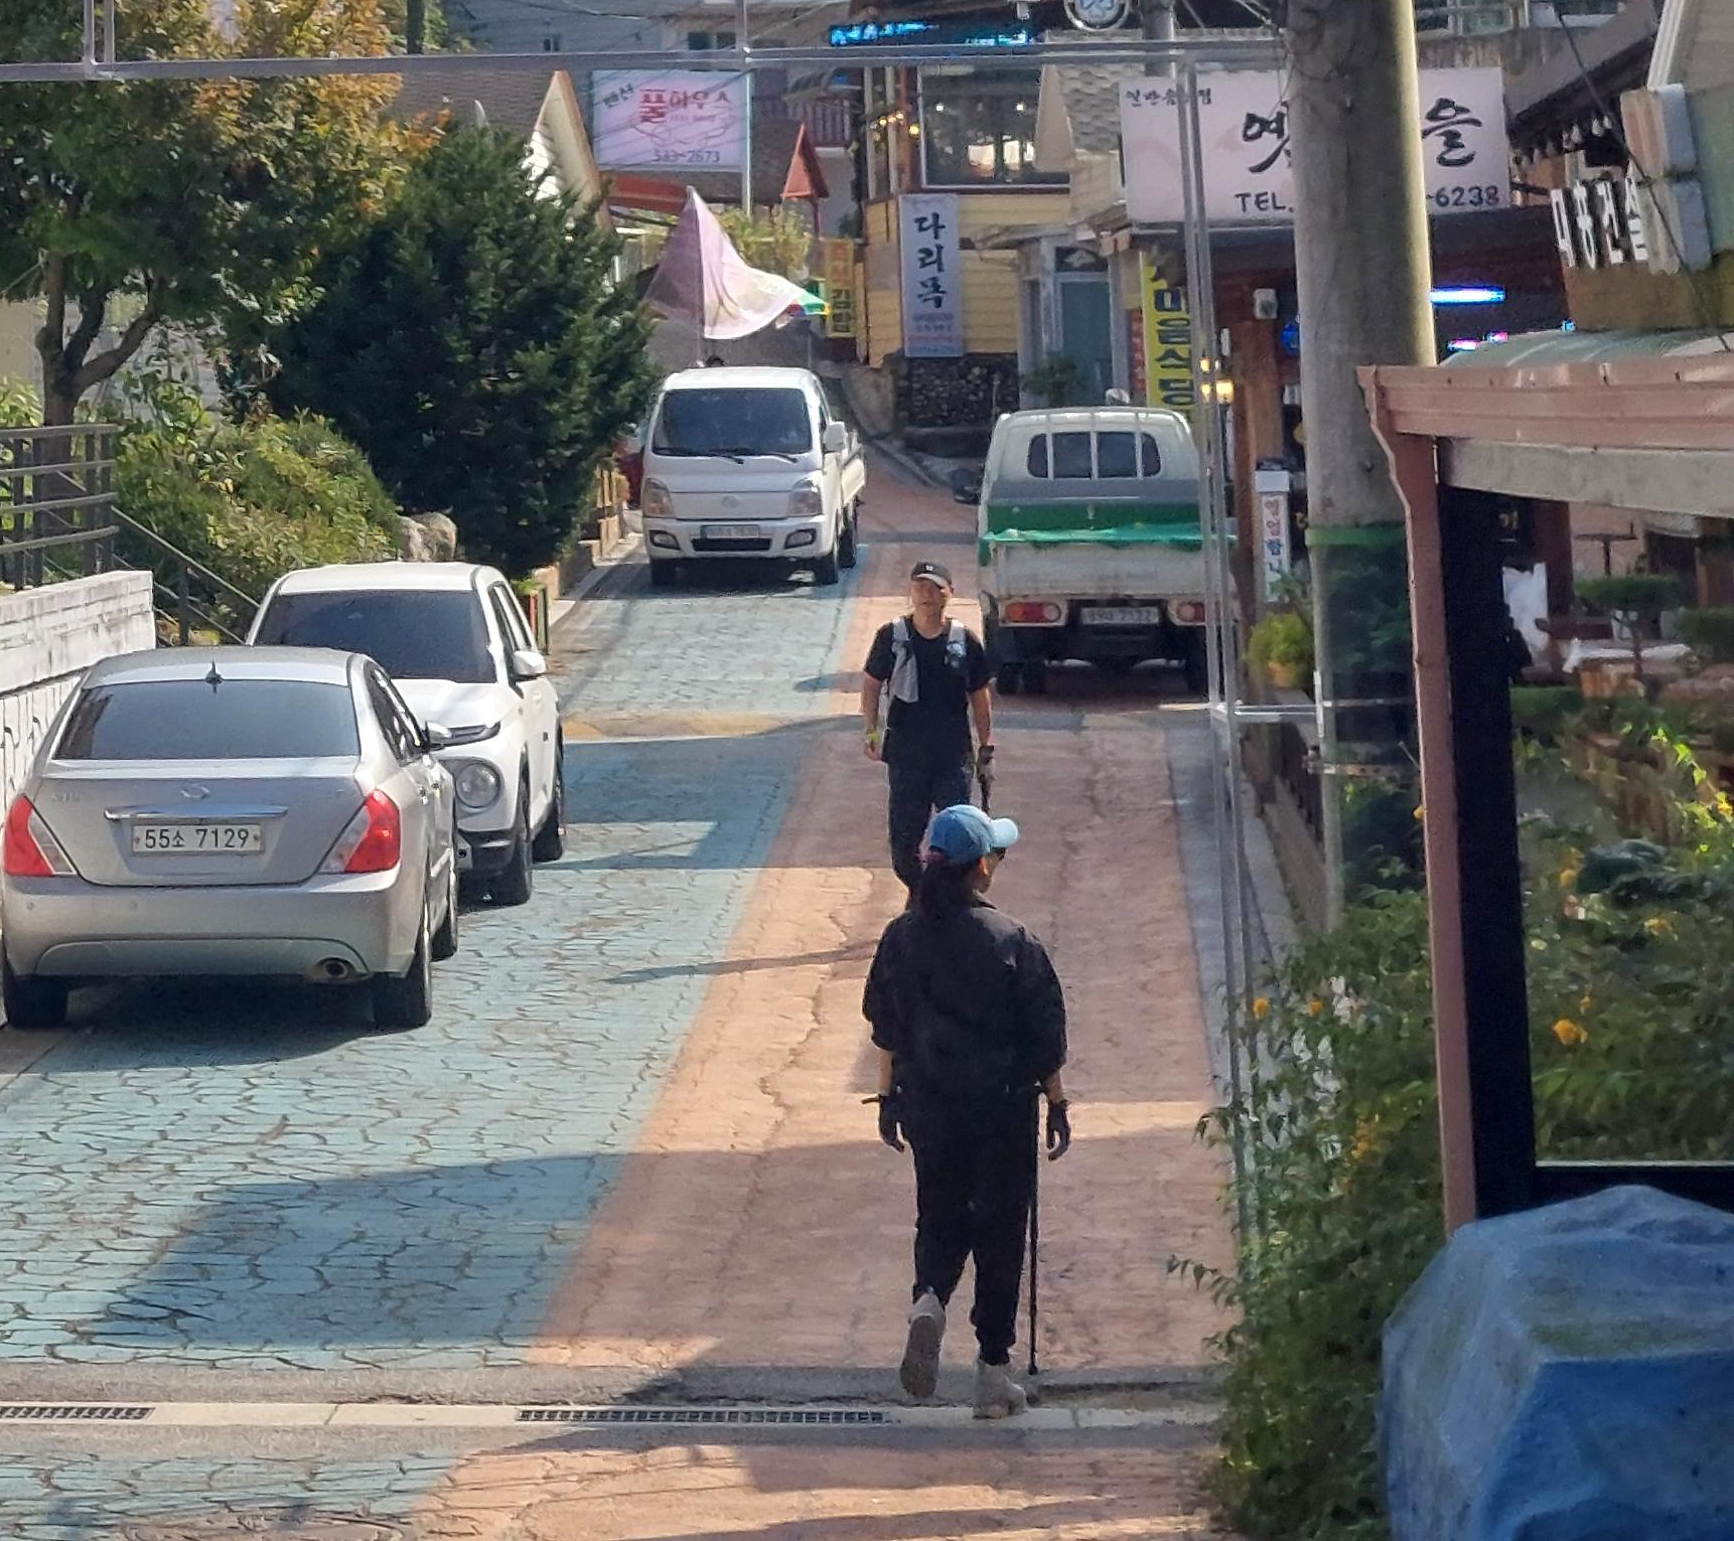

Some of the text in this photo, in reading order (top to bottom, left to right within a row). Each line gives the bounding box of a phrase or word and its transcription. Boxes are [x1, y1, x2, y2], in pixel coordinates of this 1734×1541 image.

[914, 212, 947, 309] 다리목
[145, 828, 250, 849] 55소 7129
